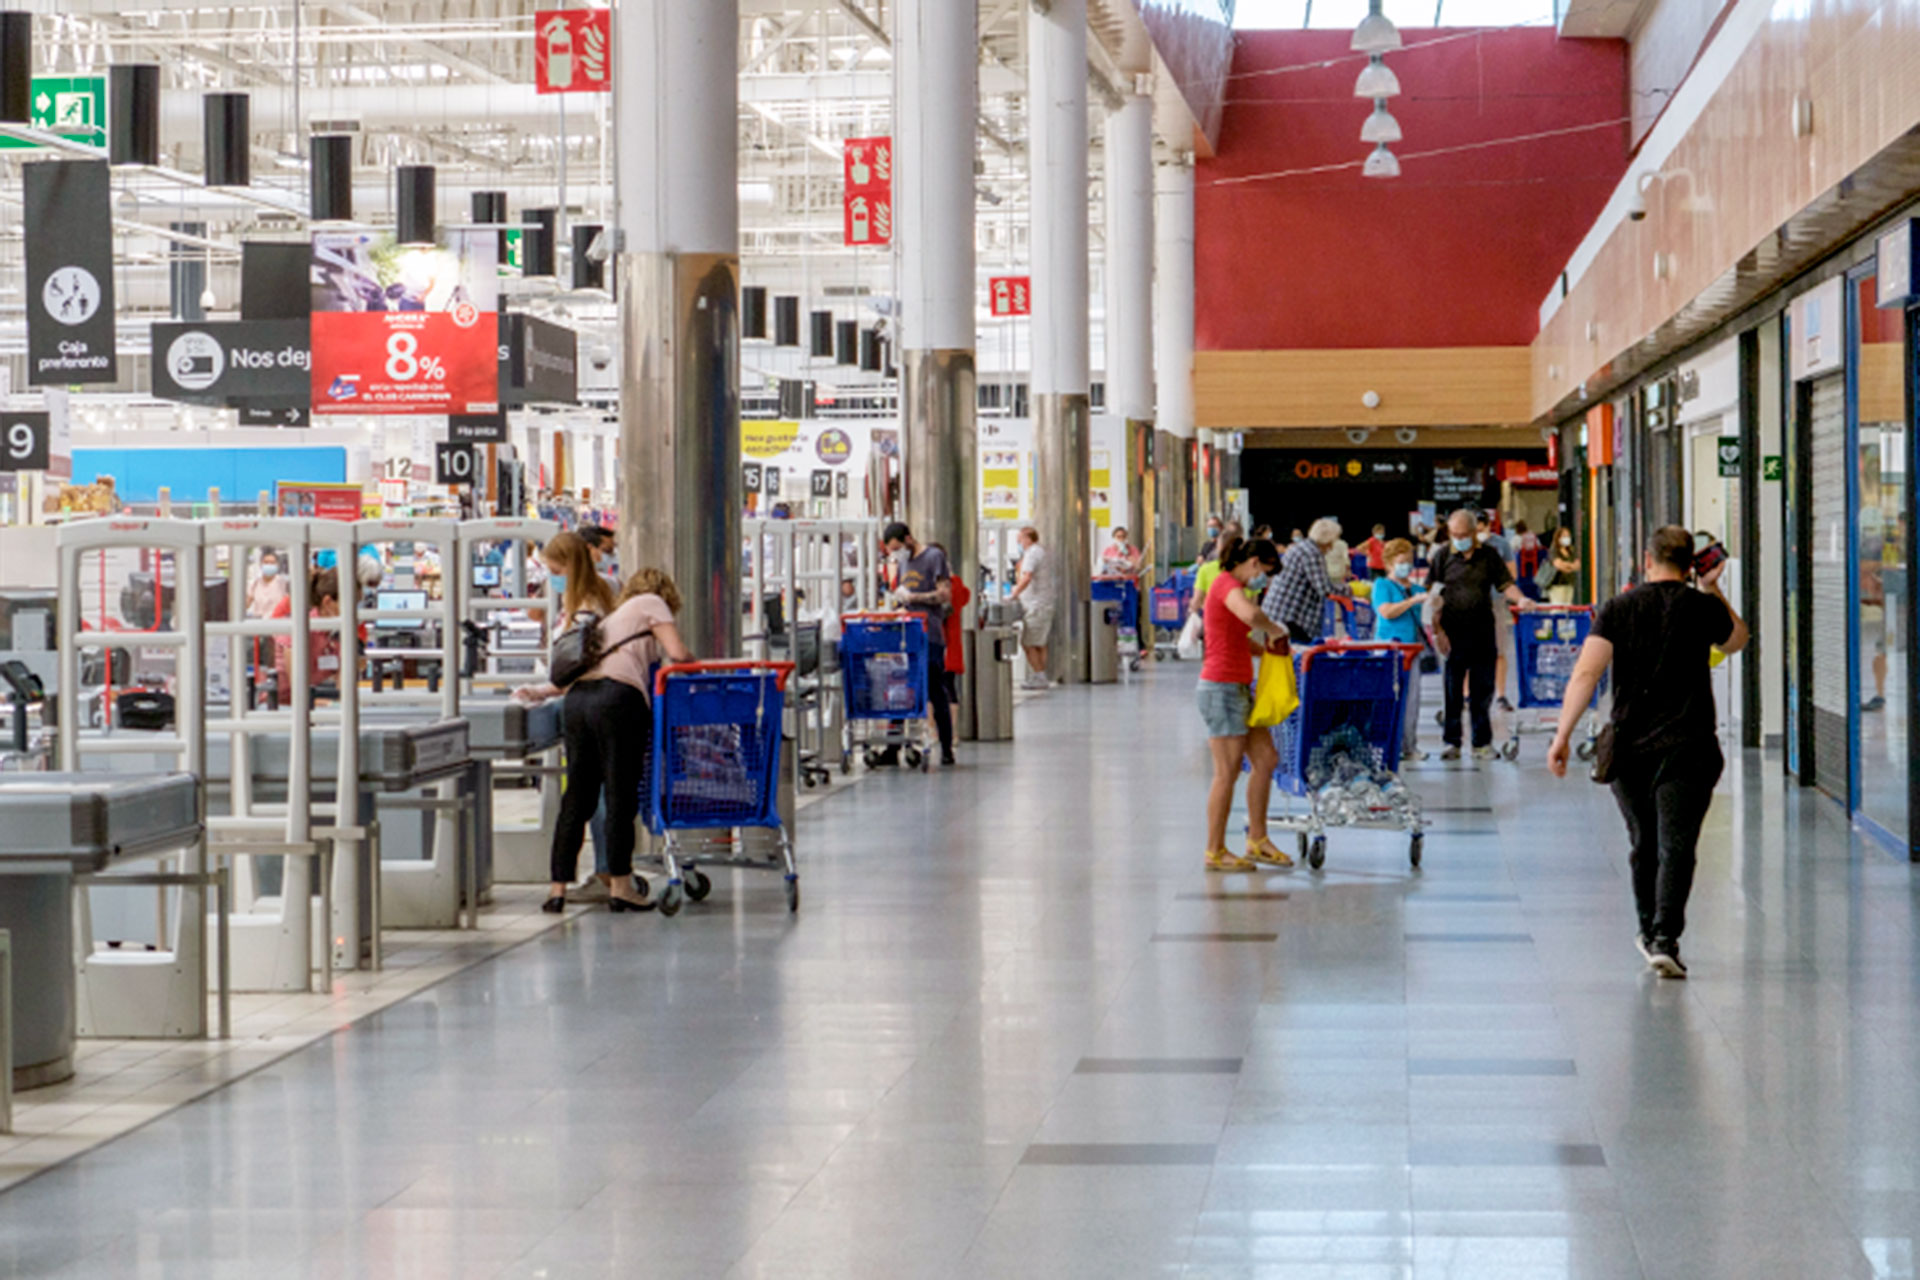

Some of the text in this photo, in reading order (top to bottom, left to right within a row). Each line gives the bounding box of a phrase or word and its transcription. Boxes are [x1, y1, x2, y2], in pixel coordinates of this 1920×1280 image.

[58, 340, 87, 356] Caja
[385, 331, 446, 381] 8%
[39, 356, 109, 372] preferente
[231, 349, 273, 367] Nos
[9, 423, 35, 459] 9
[385, 458, 412, 478] 12
[440, 450, 471, 477] 10
[814, 474, 830, 492] 17
